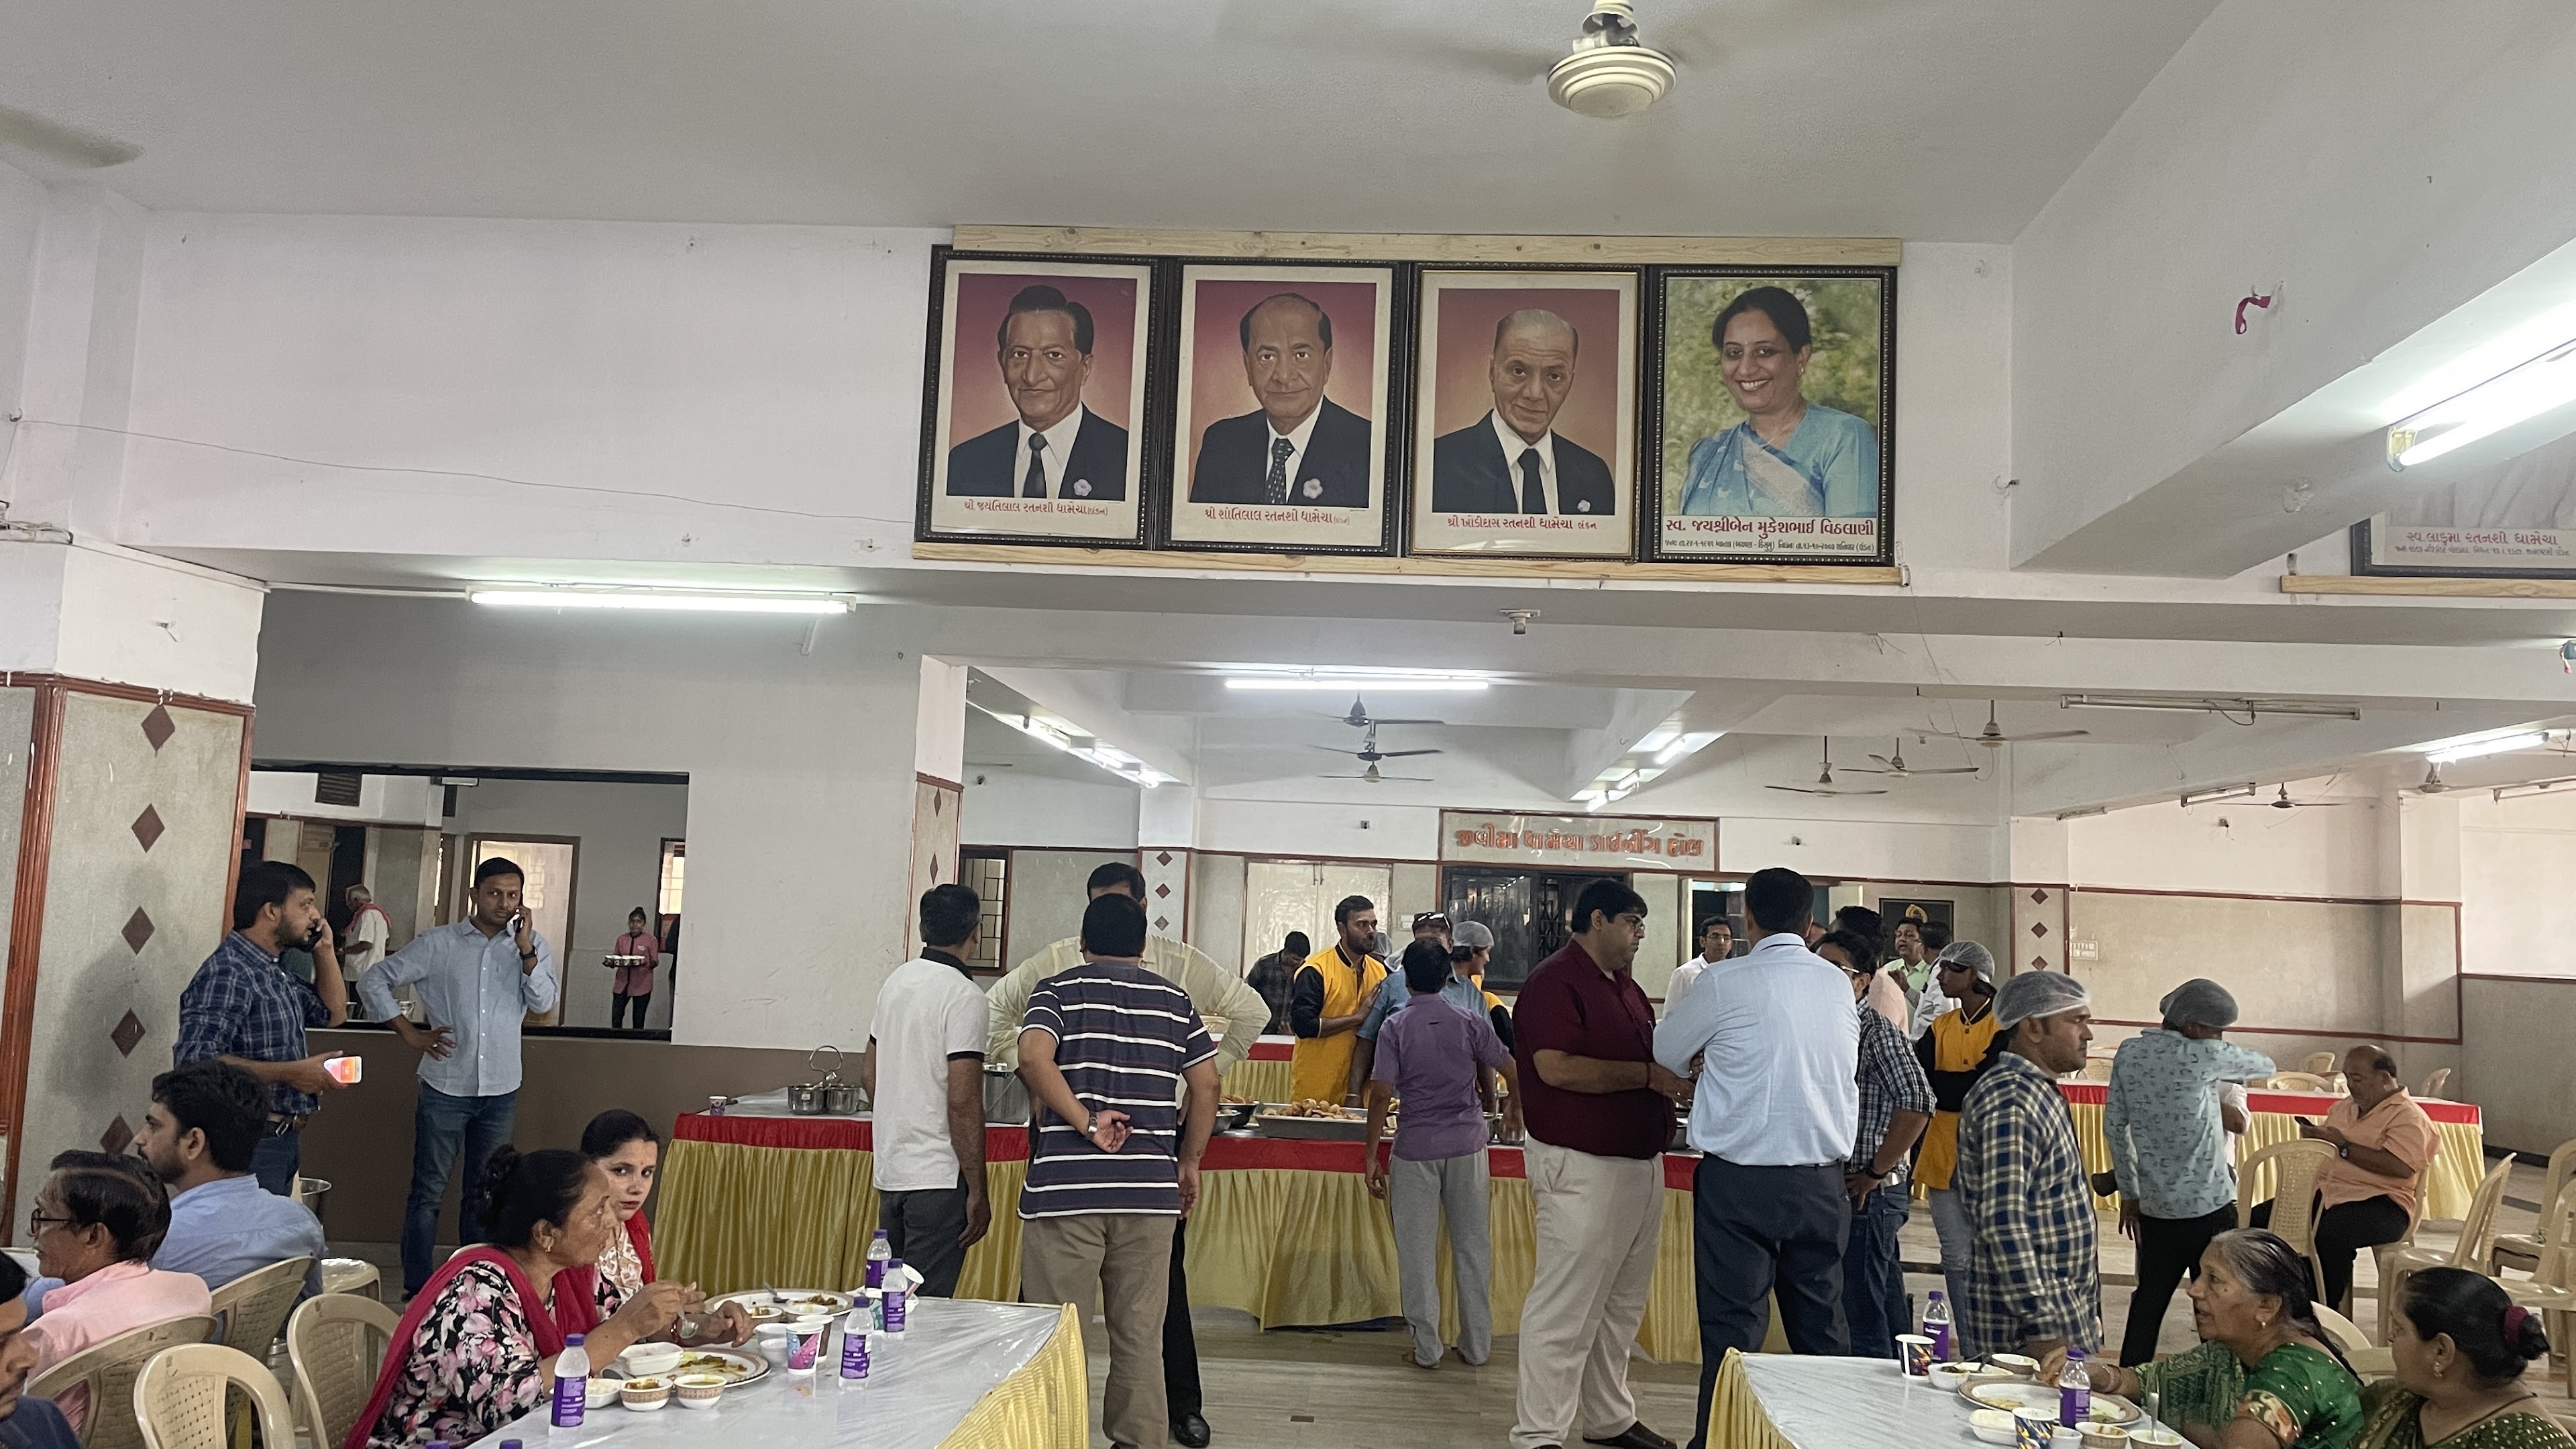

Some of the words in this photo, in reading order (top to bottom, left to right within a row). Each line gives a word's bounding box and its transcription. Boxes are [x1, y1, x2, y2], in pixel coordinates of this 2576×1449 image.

[977, 499, 1021, 512] જયંતિલાલ
[1023, 501, 1054, 513] રતનશી
[1057, 500, 1088, 515] ધામેચા
[1218, 507, 1263, 521] શાંતિલાલ
[1265, 508, 1299, 523] રતનશી
[1301, 508, 1334, 524] ધામેચા
[1461, 515, 1501, 529] ખોડીદાસ
[1502, 517, 1536, 529] રતનશી
[1539, 516, 1574, 530] ધામેચા
[1577, 519, 1597, 530] લંડન
[1666, 519, 1686, 531] સ્વ.
[1692, 516, 1754, 533] જયશ્રીબેન
[1758, 517, 1816, 539] મુકેશભાઈ
[1820, 519, 1874, 535] વિઠલાણી
[2465, 531, 2508, 544] રતનશી
[2514, 531, 2558, 545] ધામેચા
[1523, 827, 1585, 851] ધામેચા
[1667, 833, 1704, 857] હોલ
